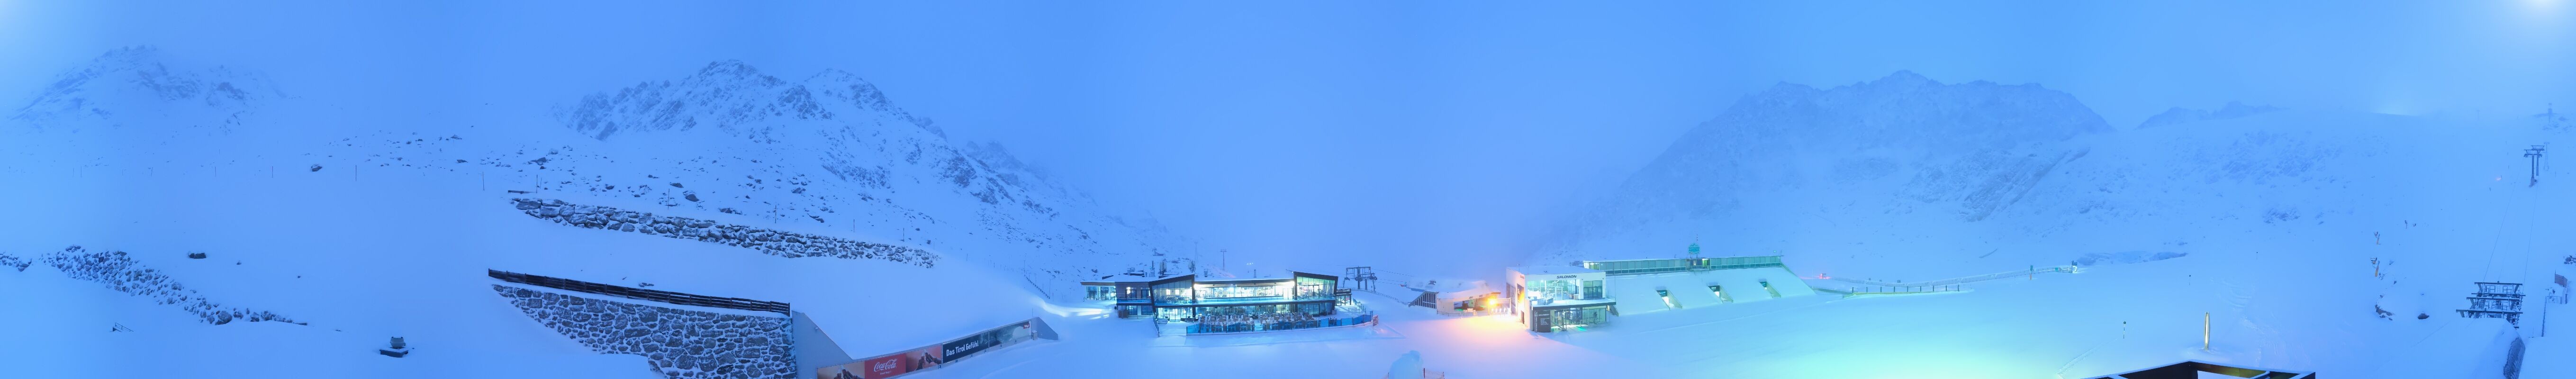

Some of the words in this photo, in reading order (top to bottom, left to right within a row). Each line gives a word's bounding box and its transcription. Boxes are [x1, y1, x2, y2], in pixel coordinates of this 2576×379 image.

[946, 349, 955, 357] Das
[955, 344, 966, 354] Tirol
[966, 340, 979, 350] Gefühl
